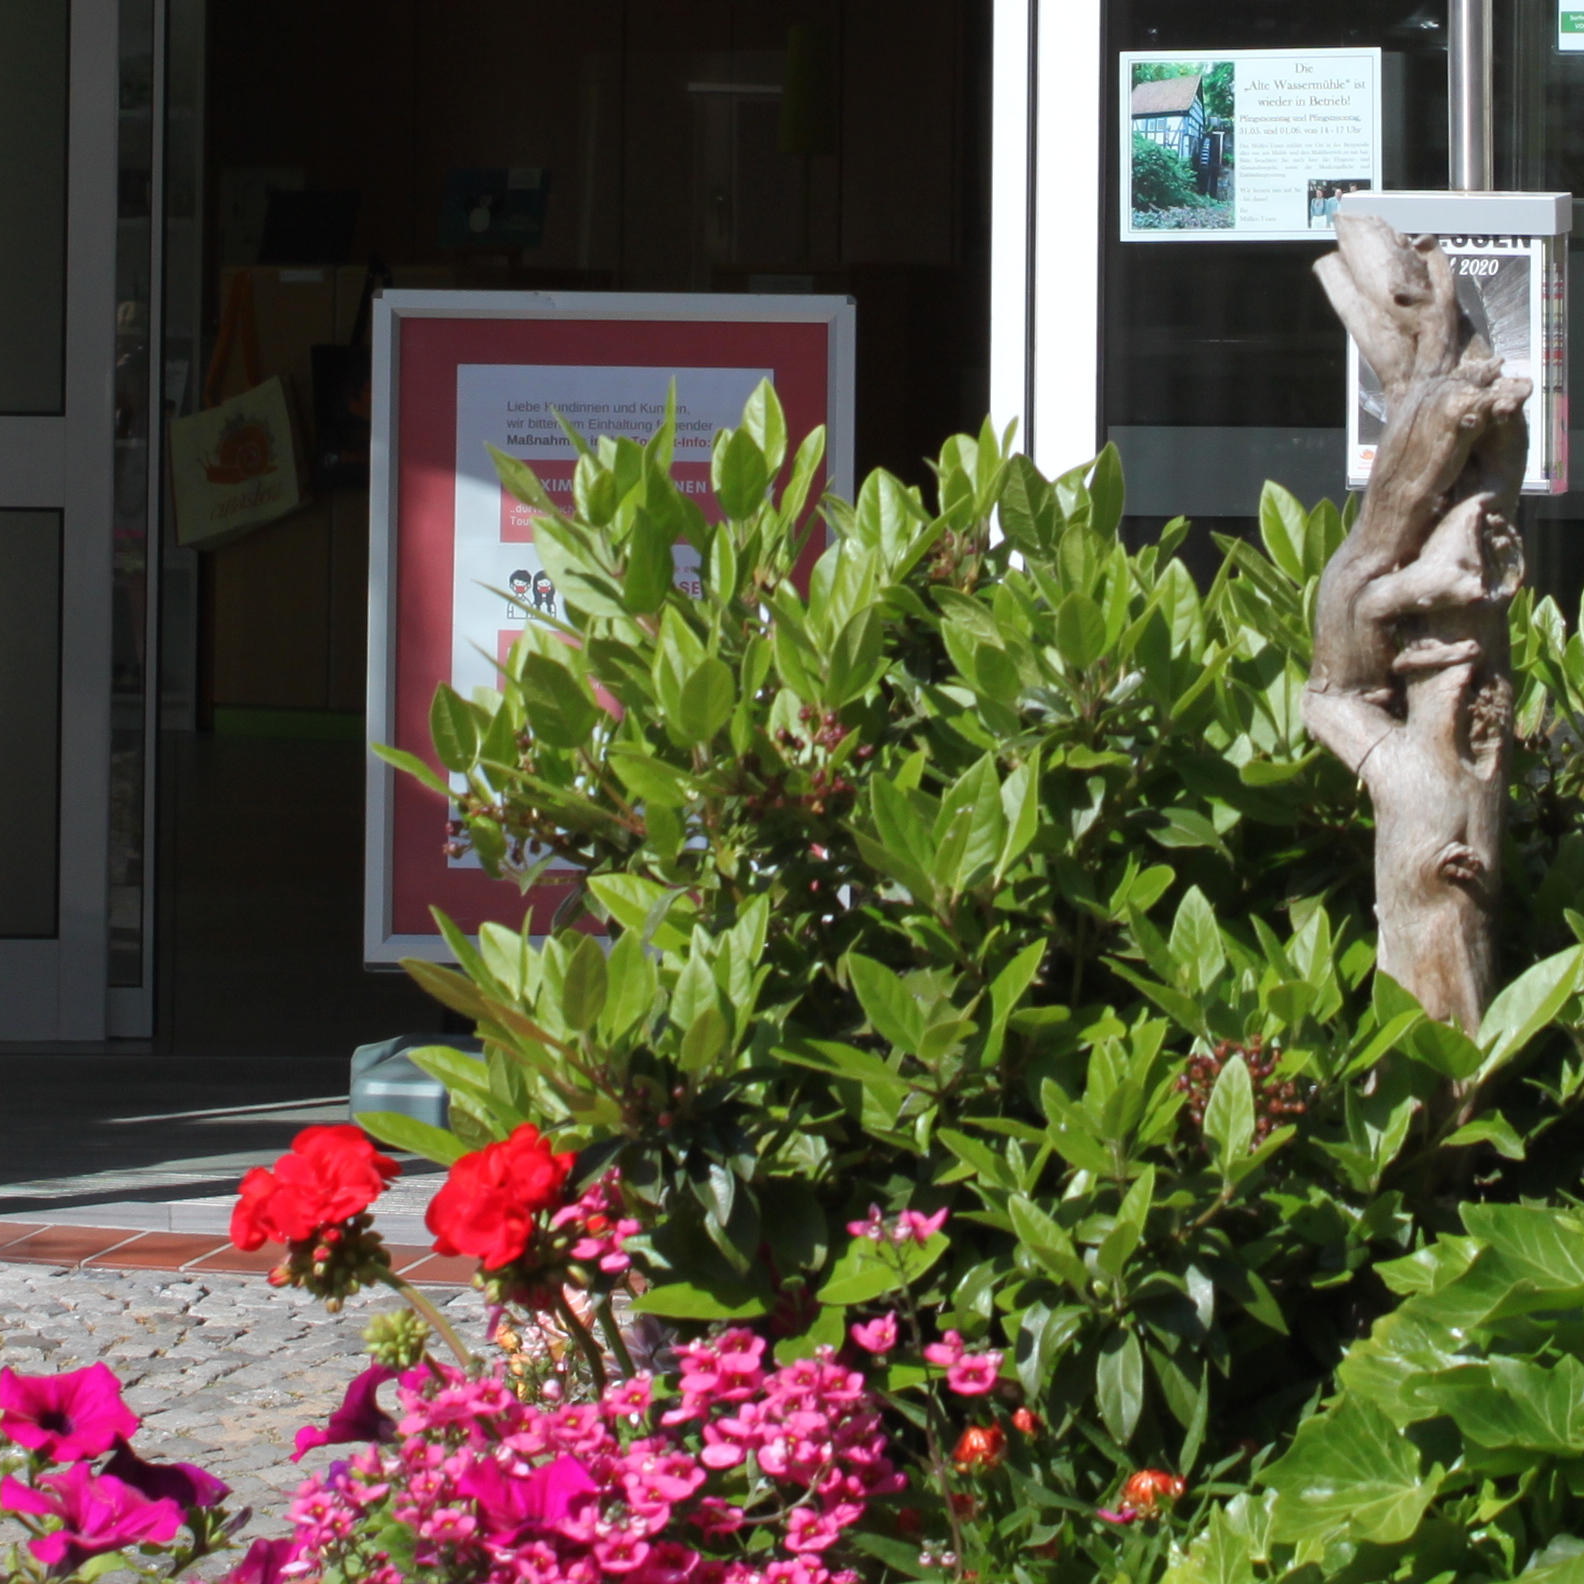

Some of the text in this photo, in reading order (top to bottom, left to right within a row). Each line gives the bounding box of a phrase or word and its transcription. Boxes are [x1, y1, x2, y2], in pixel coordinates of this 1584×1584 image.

[1295, 63, 1314, 74] Die
[1354, 80, 1366, 89] ist
[1258, 96, 1351, 106] wieder in Betrieb!
[1459, 259, 1499, 275] 2020
[507, 402, 540, 412] Liebe
[614, 403, 636, 413] und
[640, 403, 690, 414] Kunen,
[507, 418, 524, 428] wir
[589, 419, 652, 432] Einhaltung
[507, 435, 570, 445] Maßnahm
